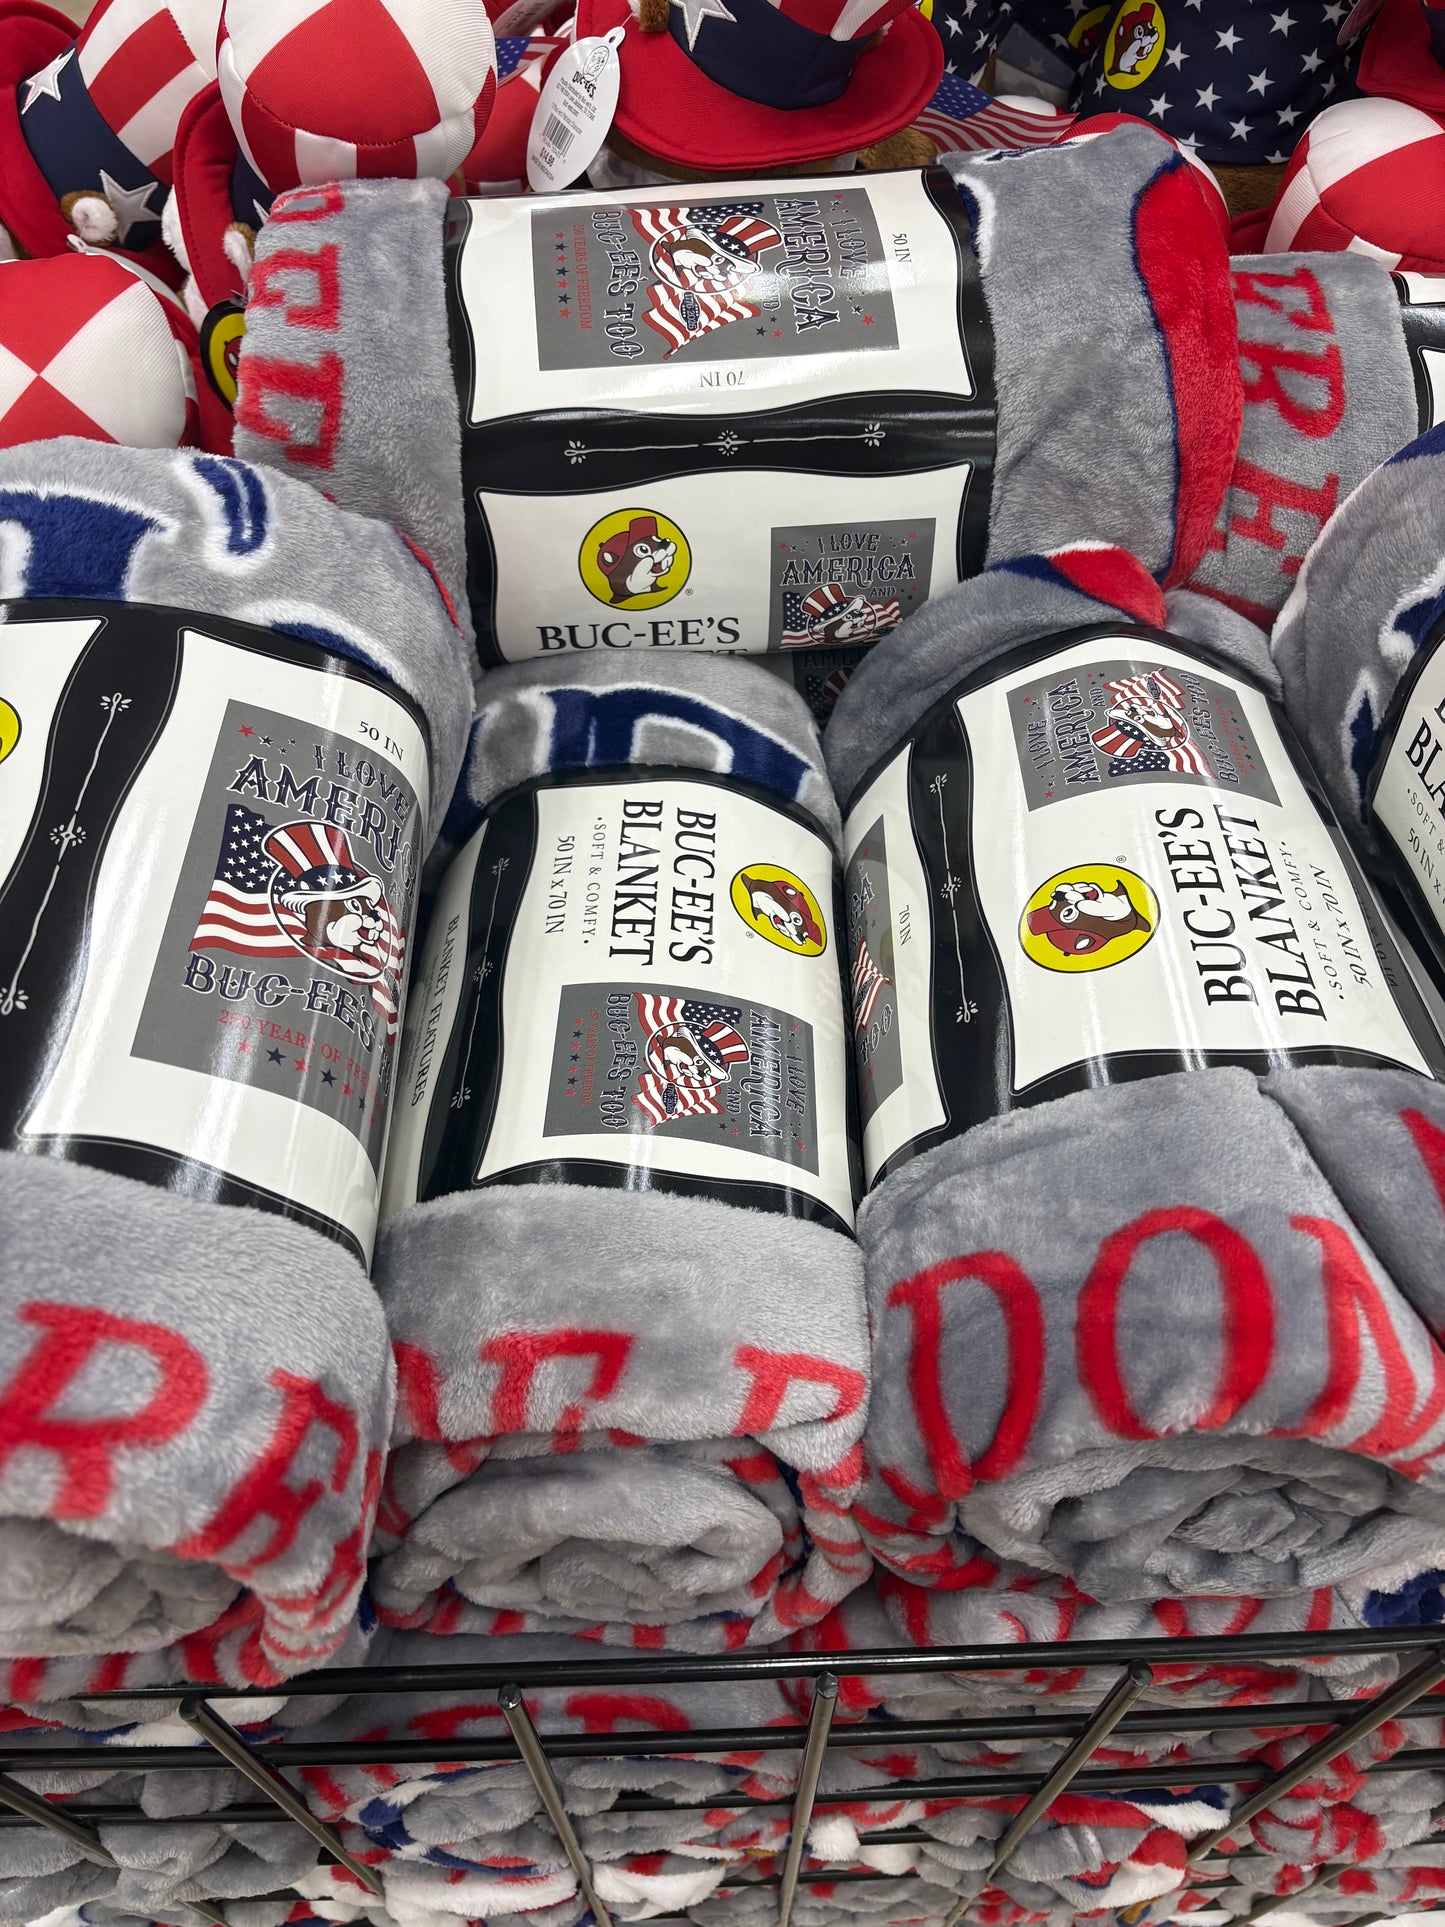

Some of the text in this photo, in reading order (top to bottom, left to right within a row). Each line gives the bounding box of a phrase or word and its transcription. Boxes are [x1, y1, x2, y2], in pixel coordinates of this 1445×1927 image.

[574, 236, 588, 264] YEARS
[773, 198, 840, 334] AMERICA
[829, 218, 869, 280] I LOVE
[892, 233, 912, 263] 50 IN
[576, 265, 588, 277] OF
[592, 210, 649, 359] BUC-EE'S TOO
[576, 278, 593, 331] FREEDOM
[700, 371, 746, 388] 70 IN
[817, 533, 882, 554] I LOVE
[779, 552, 917, 589] AMERICA
[870, 586, 896, 597] AND
[536, 616, 741, 650] BUC-EE'S
[1088, 688, 1107, 708] AND
[1179, 673, 1209, 704] TOO
[358, 720, 405, 762] 50 IN
[1027, 719, 1056, 771] I LOVE
[1046, 678, 1102, 785] AMERICA
[313, 744, 411, 826] I LOVE
[1411, 789, 1436, 837] SOFT
[552, 855, 573, 875] IN
[556, 835, 575, 852] 50
[1407, 827, 1420, 853] 50
[1419, 848, 1435, 880] IN
[582, 823, 607, 936] SOFT & COMFY
[608, 799, 664, 966] BLANKET
[668, 807, 717, 965] BUC-EE'S
[1309, 863, 1333, 891] IN
[548, 891, 568, 910] 70
[1154, 808, 1260, 1007] BUC-EE'S
[1213, 803, 1328, 1022] BLANKET
[1278, 847, 1343, 991] SOFT & COMFY
[1322, 891, 1344, 915] 70
[544, 912, 566, 935] IN
[899, 904, 912, 946] 70 IN
[434, 914, 460, 997] BLANKET
[1337, 931, 1362, 961] IN
[1349, 963, 1373, 990] 50
[182, 952, 375, 1054] BUC-EE'S
[217, 1009, 251, 1030] 250
[257, 1019, 317, 1053] YEARS
[321, 1044, 343, 1064] OF
[412, 1000, 443, 1107] FEATURES
[586, 1023, 599, 1050] YEARS
[599, 993, 641, 1129] BUC-EE'S TOO
[740, 1009, 783, 1139] AMERICA
[581, 1064, 595, 1107] FREEDOM
[726, 1086, 741, 1115] AND
[785, 1055, 807, 1116] I LOVE
